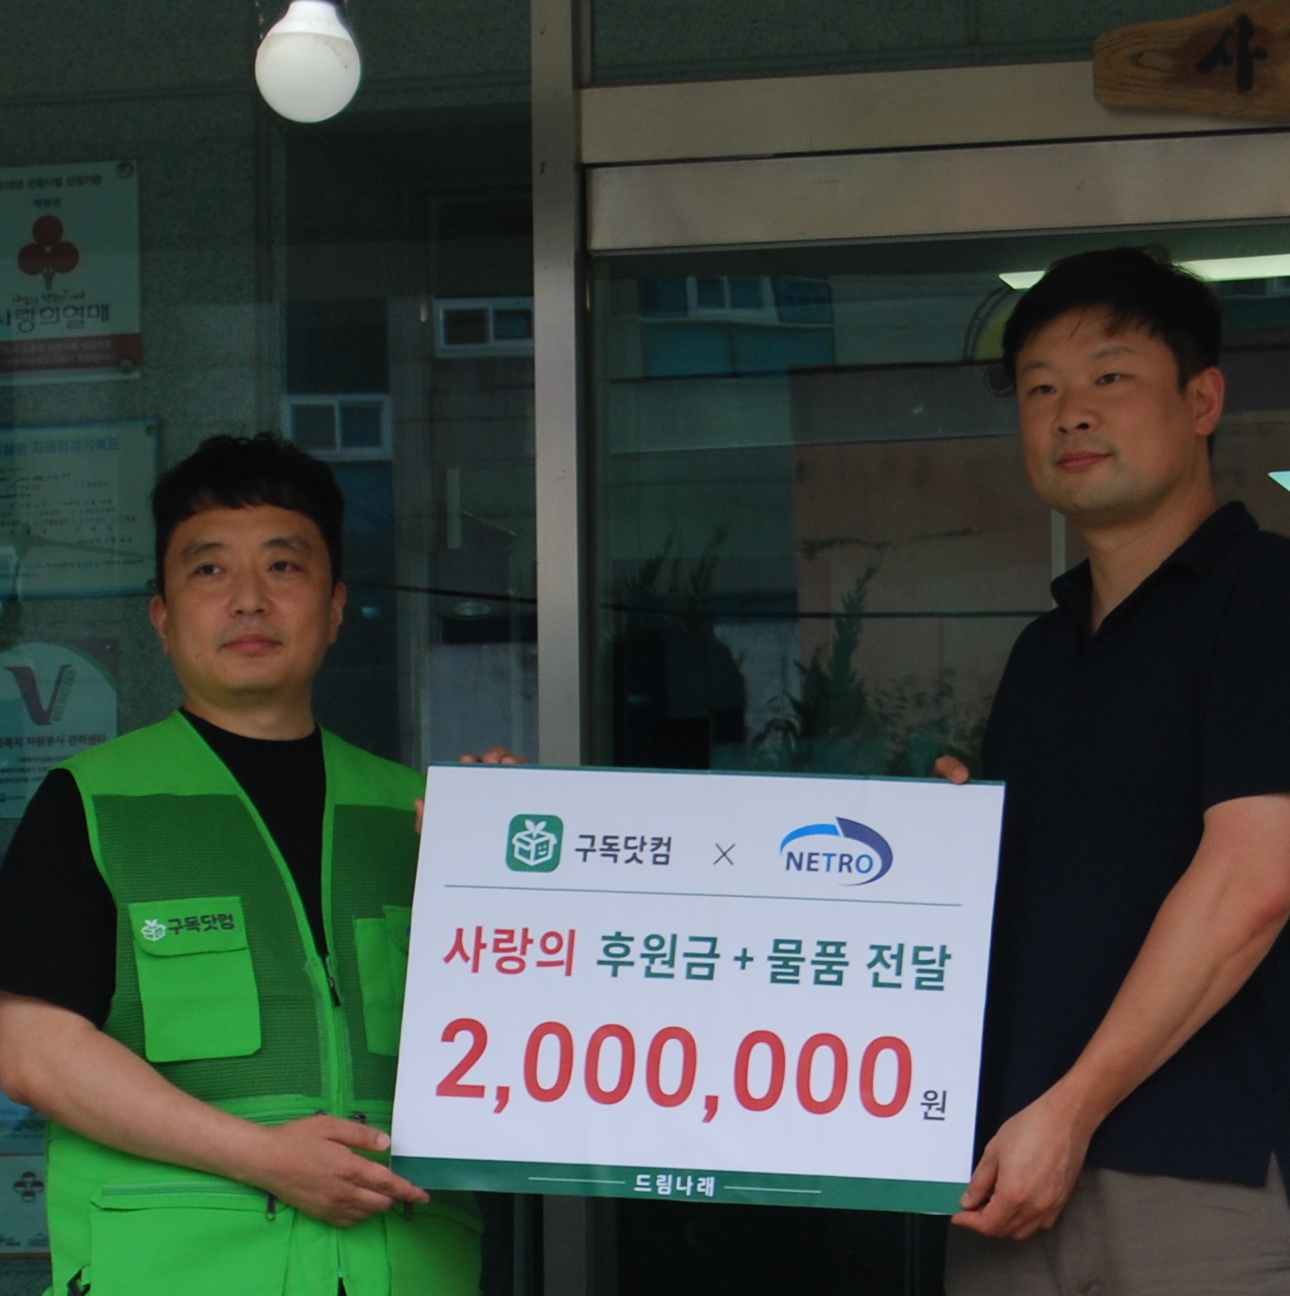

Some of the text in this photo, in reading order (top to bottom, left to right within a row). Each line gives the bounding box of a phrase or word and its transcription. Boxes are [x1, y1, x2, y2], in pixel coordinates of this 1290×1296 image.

[574, 834, 673, 867] 구독닷컴
[785, 851, 874, 876] NETRO
[443, 925, 577, 977] 사랑의
[596, 931, 721, 981] 후원금
[767, 938, 850, 988] 물품
[866, 943, 952, 991] 전달
[634, 1174, 715, 1196] 드림나래
